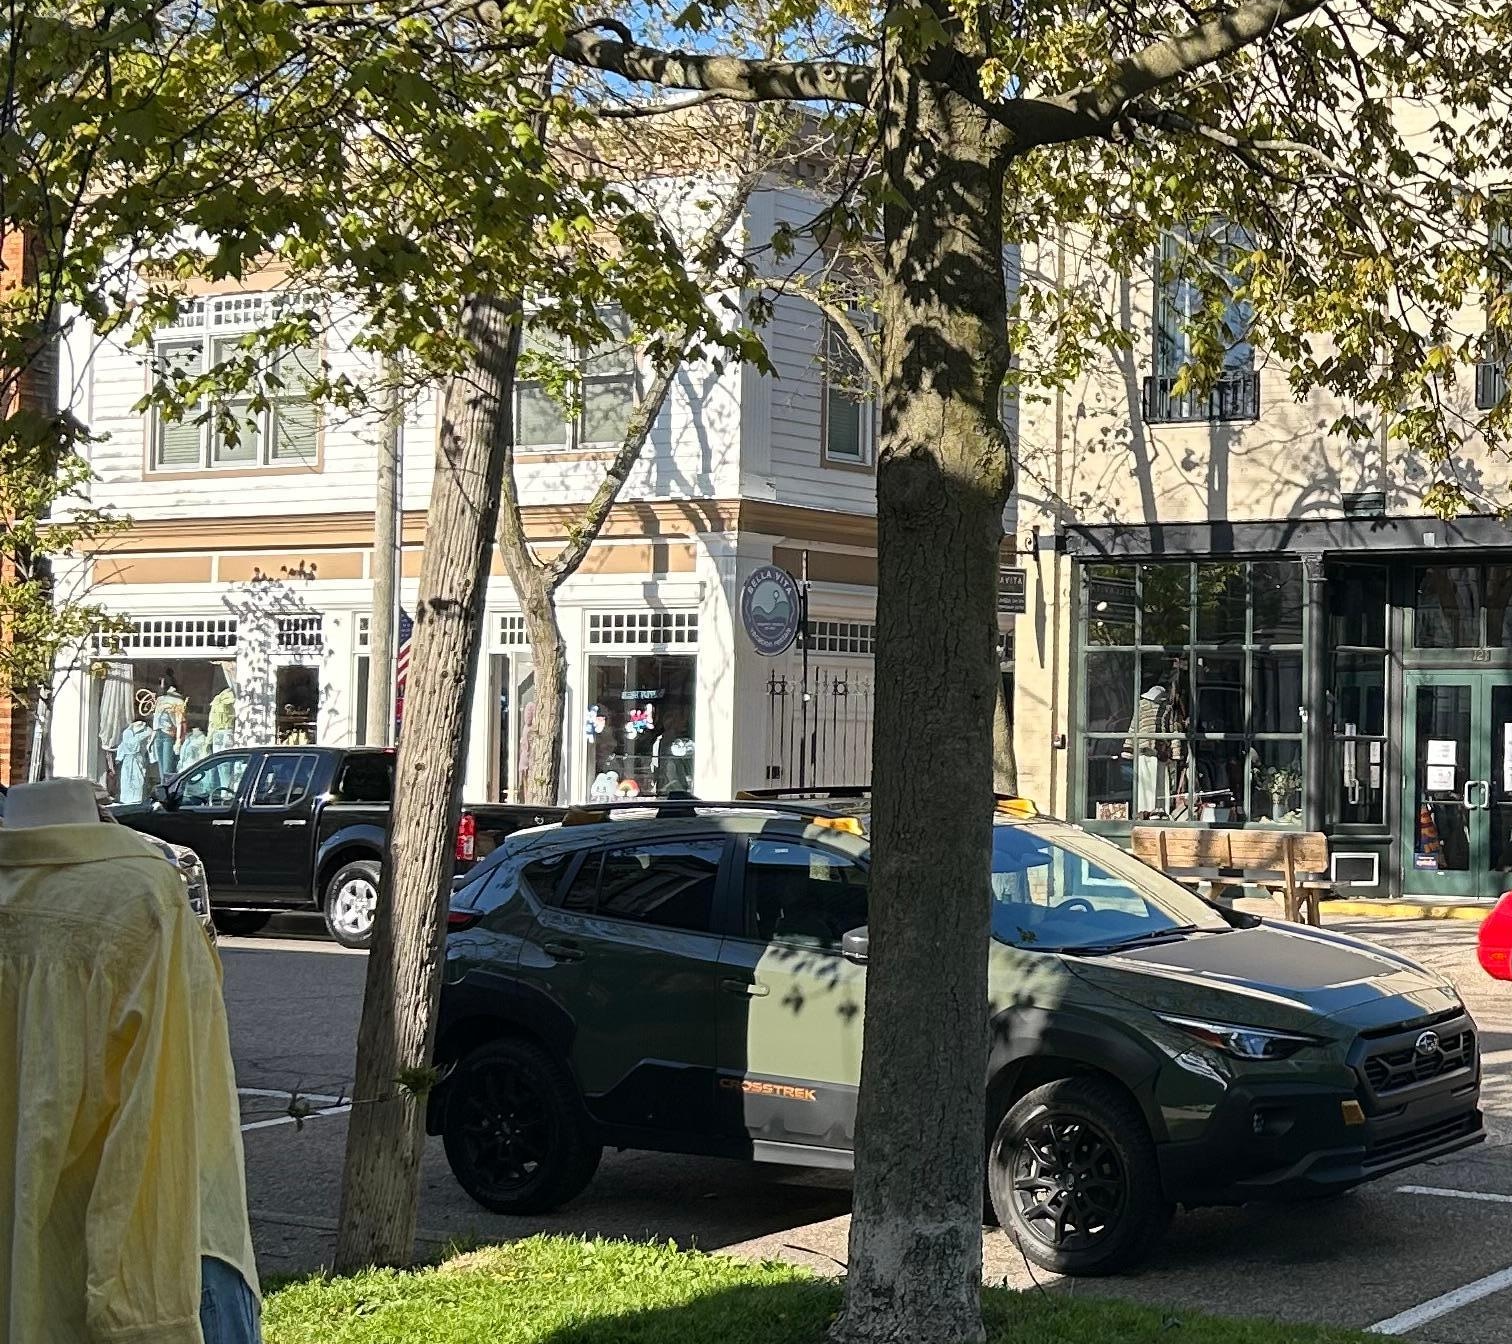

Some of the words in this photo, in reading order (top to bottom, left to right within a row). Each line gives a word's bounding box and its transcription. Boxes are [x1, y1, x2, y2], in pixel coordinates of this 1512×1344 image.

[747, 571, 772, 594] BELLA
[775, 572, 793, 594] VITA
[719, 1078, 817, 1102] CROSSTREK
